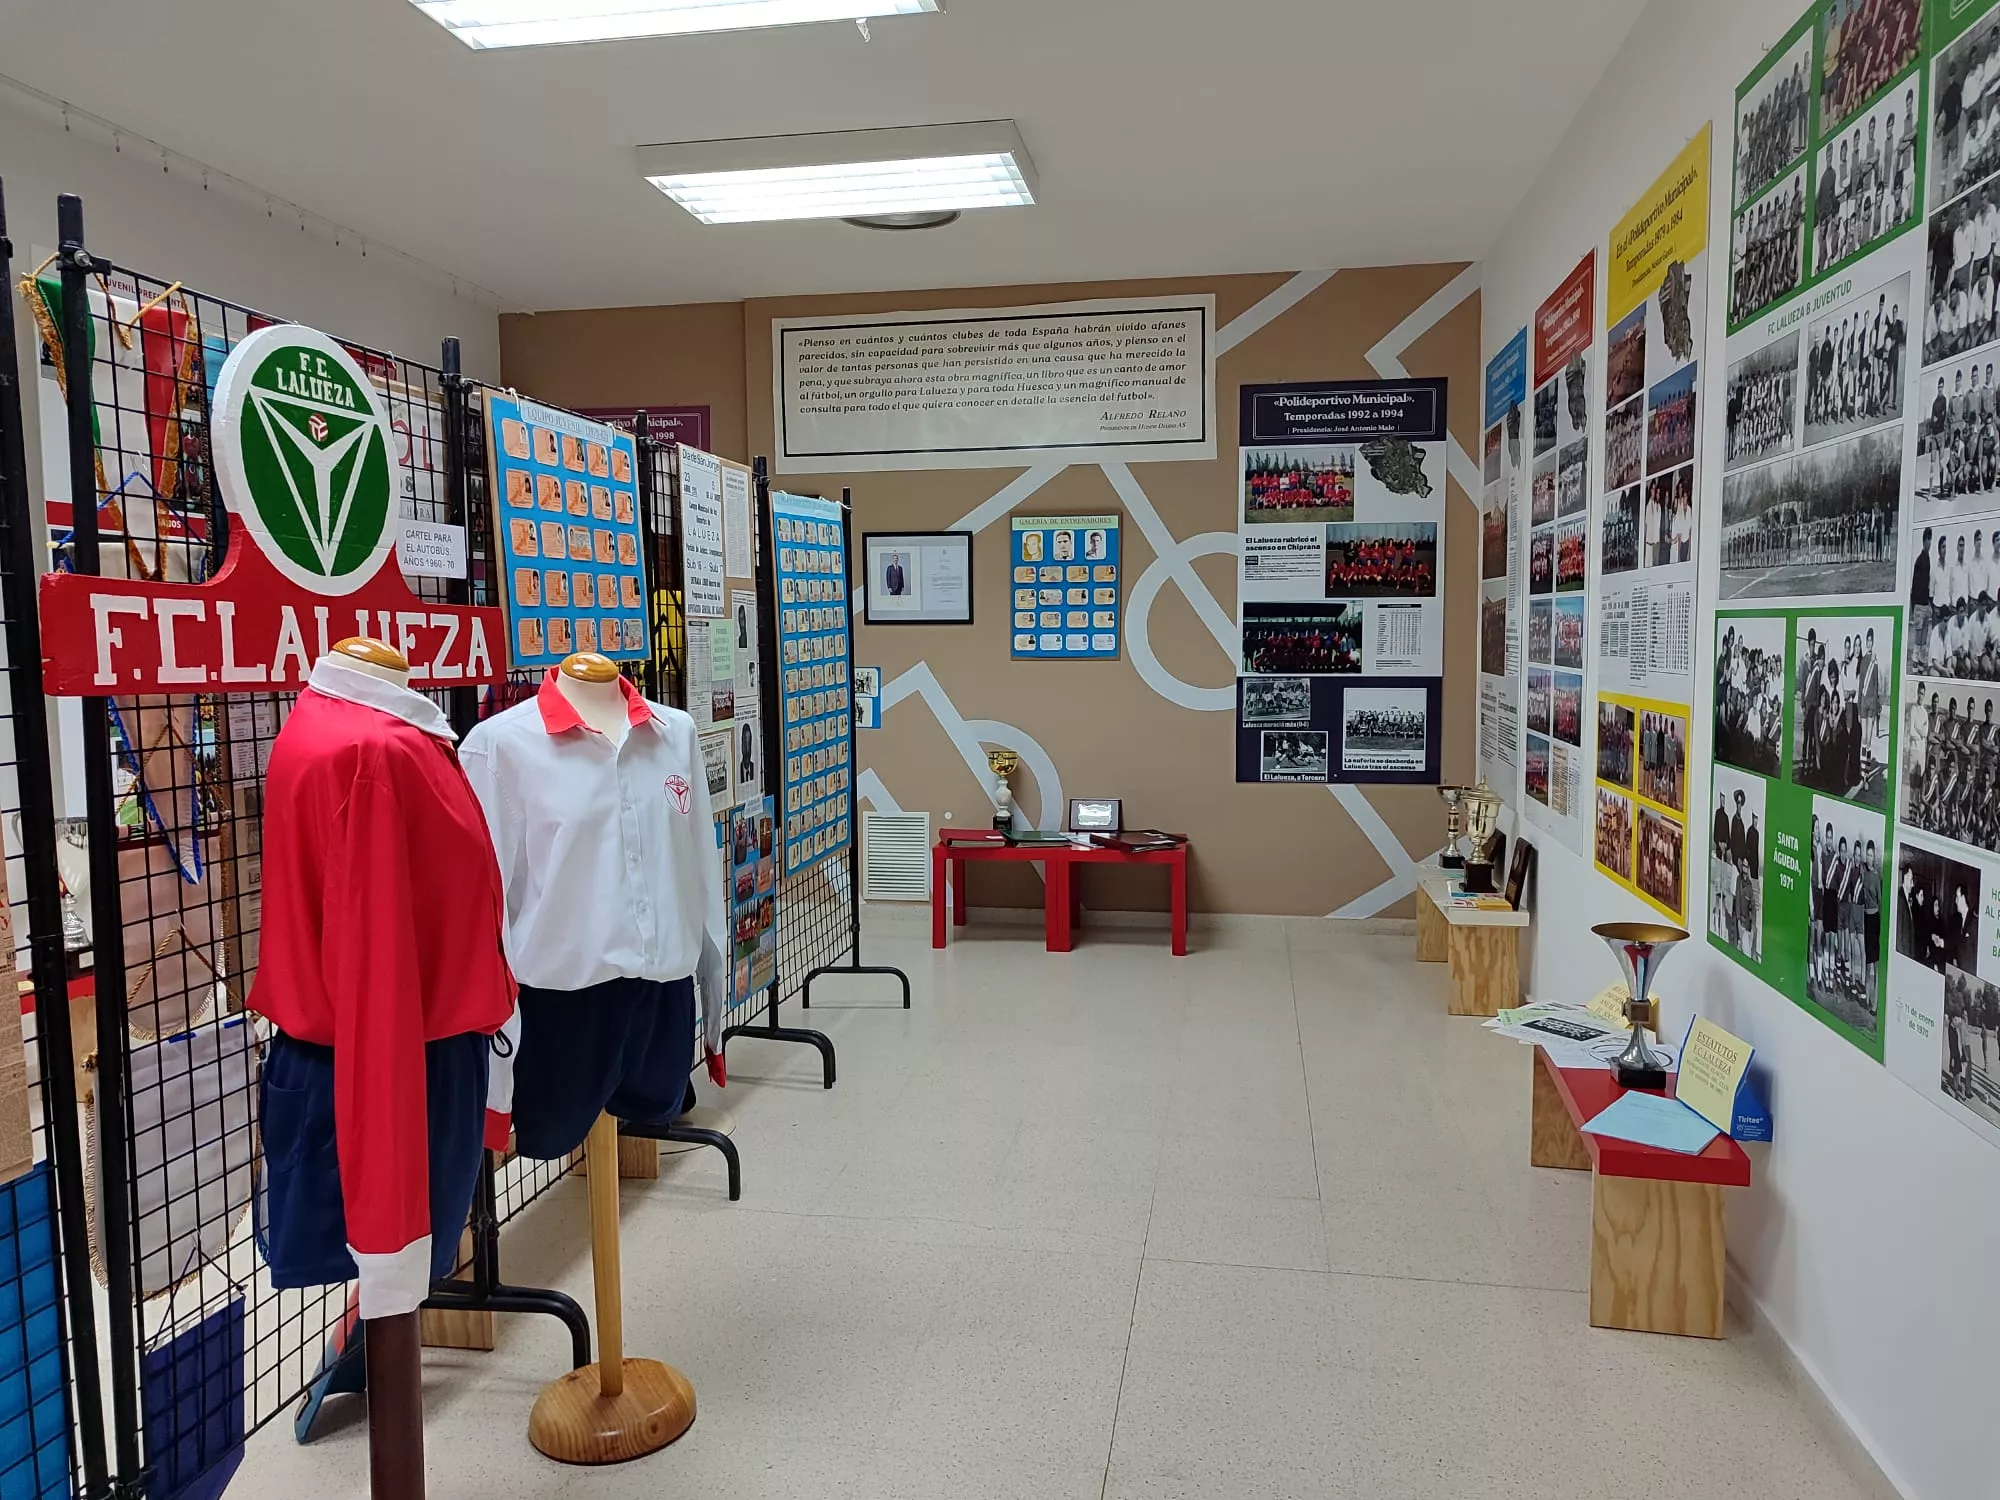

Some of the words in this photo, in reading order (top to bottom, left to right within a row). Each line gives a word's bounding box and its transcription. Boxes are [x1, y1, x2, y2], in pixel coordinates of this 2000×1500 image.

[1768, 321, 1775, 336] FC
[1777, 306, 1805, 331] LALUEZA
[1806, 302, 1811, 315] B
[1812, 280, 1852, 312] JUVENTUD
[856, 336, 894, 345] cuántos
[898, 336, 905, 345] y
[909, 332, 947, 342] cuántos
[952, 331, 983, 340] clubes
[988, 330, 1000, 338] de
[1005, 328, 1027, 337] toda
[1032, 326, 1069, 338] España
[1074, 324, 1111, 334] habrán
[1116, 322, 1146, 332] vivido
[1151, 320, 1186, 331] afanes
[799, 351, 848, 362] parecidos,
[851, 349, 865, 358] sin
[868, 347, 918, 359] capacidad
[921, 347, 944, 356] para
[947, 343, 995, 353] sobrevivir
[998, 342, 1019, 351] más
[1022, 344, 1041, 352] que
[1043, 340, 1083, 350] algunos
[1086, 338, 1113, 347] años,
[1115, 339, 1122, 347] y
[1125, 336, 1158, 347] pienso
[1177, 334, 1186, 343] el
[799, 365, 824, 374] valor
[827, 364, 838, 373] de
[841, 363, 872, 372] tantas
[875, 361, 919, 372] personas
[921, 361, 939, 370] que
[943, 359, 961, 367] han
[964, 356, 1014, 368] persistido
[1016, 356, 1029, 364] en
[1031, 355, 1051, 363] una
[1054, 354, 1084, 362] causa
[1087, 353, 1106, 363] que
[1109, 351, 1122, 360] ha
[1125, 348, 1173, 359] merecido
[1176, 348, 1186, 356] la
[799, 379, 825, 388] pena,
[826, 379, 833, 388] y
[834, 379, 852, 388] que
[853, 376, 892, 386] subraya
[894, 376, 923, 384] ahora
[925, 374, 945, 383] esta
[947, 373, 969, 382] obra
[972, 371, 1025, 382] magnífica,
[1026, 371, 1039, 379] un
[1042, 370, 1064, 378] libro
[1066, 367, 1084, 377] que
[1087, 367, 1097, 375] es
[1114, 365, 1143, 373] canto
[1144, 363, 1157, 372] de
[1158, 363, 1187, 371] amor
[276, 367, 355, 408] LALUEZA
[799, 391, 809, 400] al
[844, 391, 857, 399] un
[858, 389, 893, 399] orgullo
[894, 389, 917, 398] para
[920, 386, 958, 396] Lalueza
[959, 387, 966, 396] y
[967, 385, 990, 395] para
[992, 384, 1014, 392] toda
[1017, 382, 1054, 391] Huesca
[1055, 383, 1062, 391] y
[1063, 381, 1076, 389] un
[1079, 379, 1130, 389] magnífico
[1132, 376, 1172, 386] manual
[1174, 376, 1186, 384] de
[800, 404, 841, 414] consulta
[844, 404, 866, 413] para
[868, 402, 890, 411] todo
[891, 402, 900, 410] el
[902, 403, 920, 411] que
[922, 400, 953, 410] quiera
[955, 399, 994, 408] conocer
[996, 398, 1008, 406] en
[1011, 396, 1045, 405] detalle
[1047, 396, 1057, 404] la
[1059, 394, 1097, 403] esencia
[1100, 392, 1114, 401] del
[1284, 411, 1346, 423] Temporadas
[1348, 410, 1370, 419] 1992
[1381, 409, 1403, 418] 1994
[655, 432, 675, 440] 1998
[1060, 516, 1112, 525] ENTRENADORES
[405, 529, 432, 541] CARTEL
[433, 532, 452, 544] PARA
[688, 527, 720, 542] LALUEZA
[406, 543, 415, 553] EL
[403, 554, 424, 567] AÑOS
[426, 558, 442, 569] 1960
[447, 560, 455, 570] 70
[1777, 831, 1799, 852] SANTA
[1773, 847, 1801, 876] ÁGUEDA,
[1780, 873, 1793, 891] 1971
[1985, 905, 1995, 918] AL
[1904, 1003, 1909, 1013] 11
[1911, 1007, 1917, 1017] de
[1918, 1012, 1934, 1028] enero
[1909, 1020, 1915, 1030] de
[1917, 1024, 1928, 1038] 1970
[1697, 1031, 1738, 1063] ESTATUTOS
